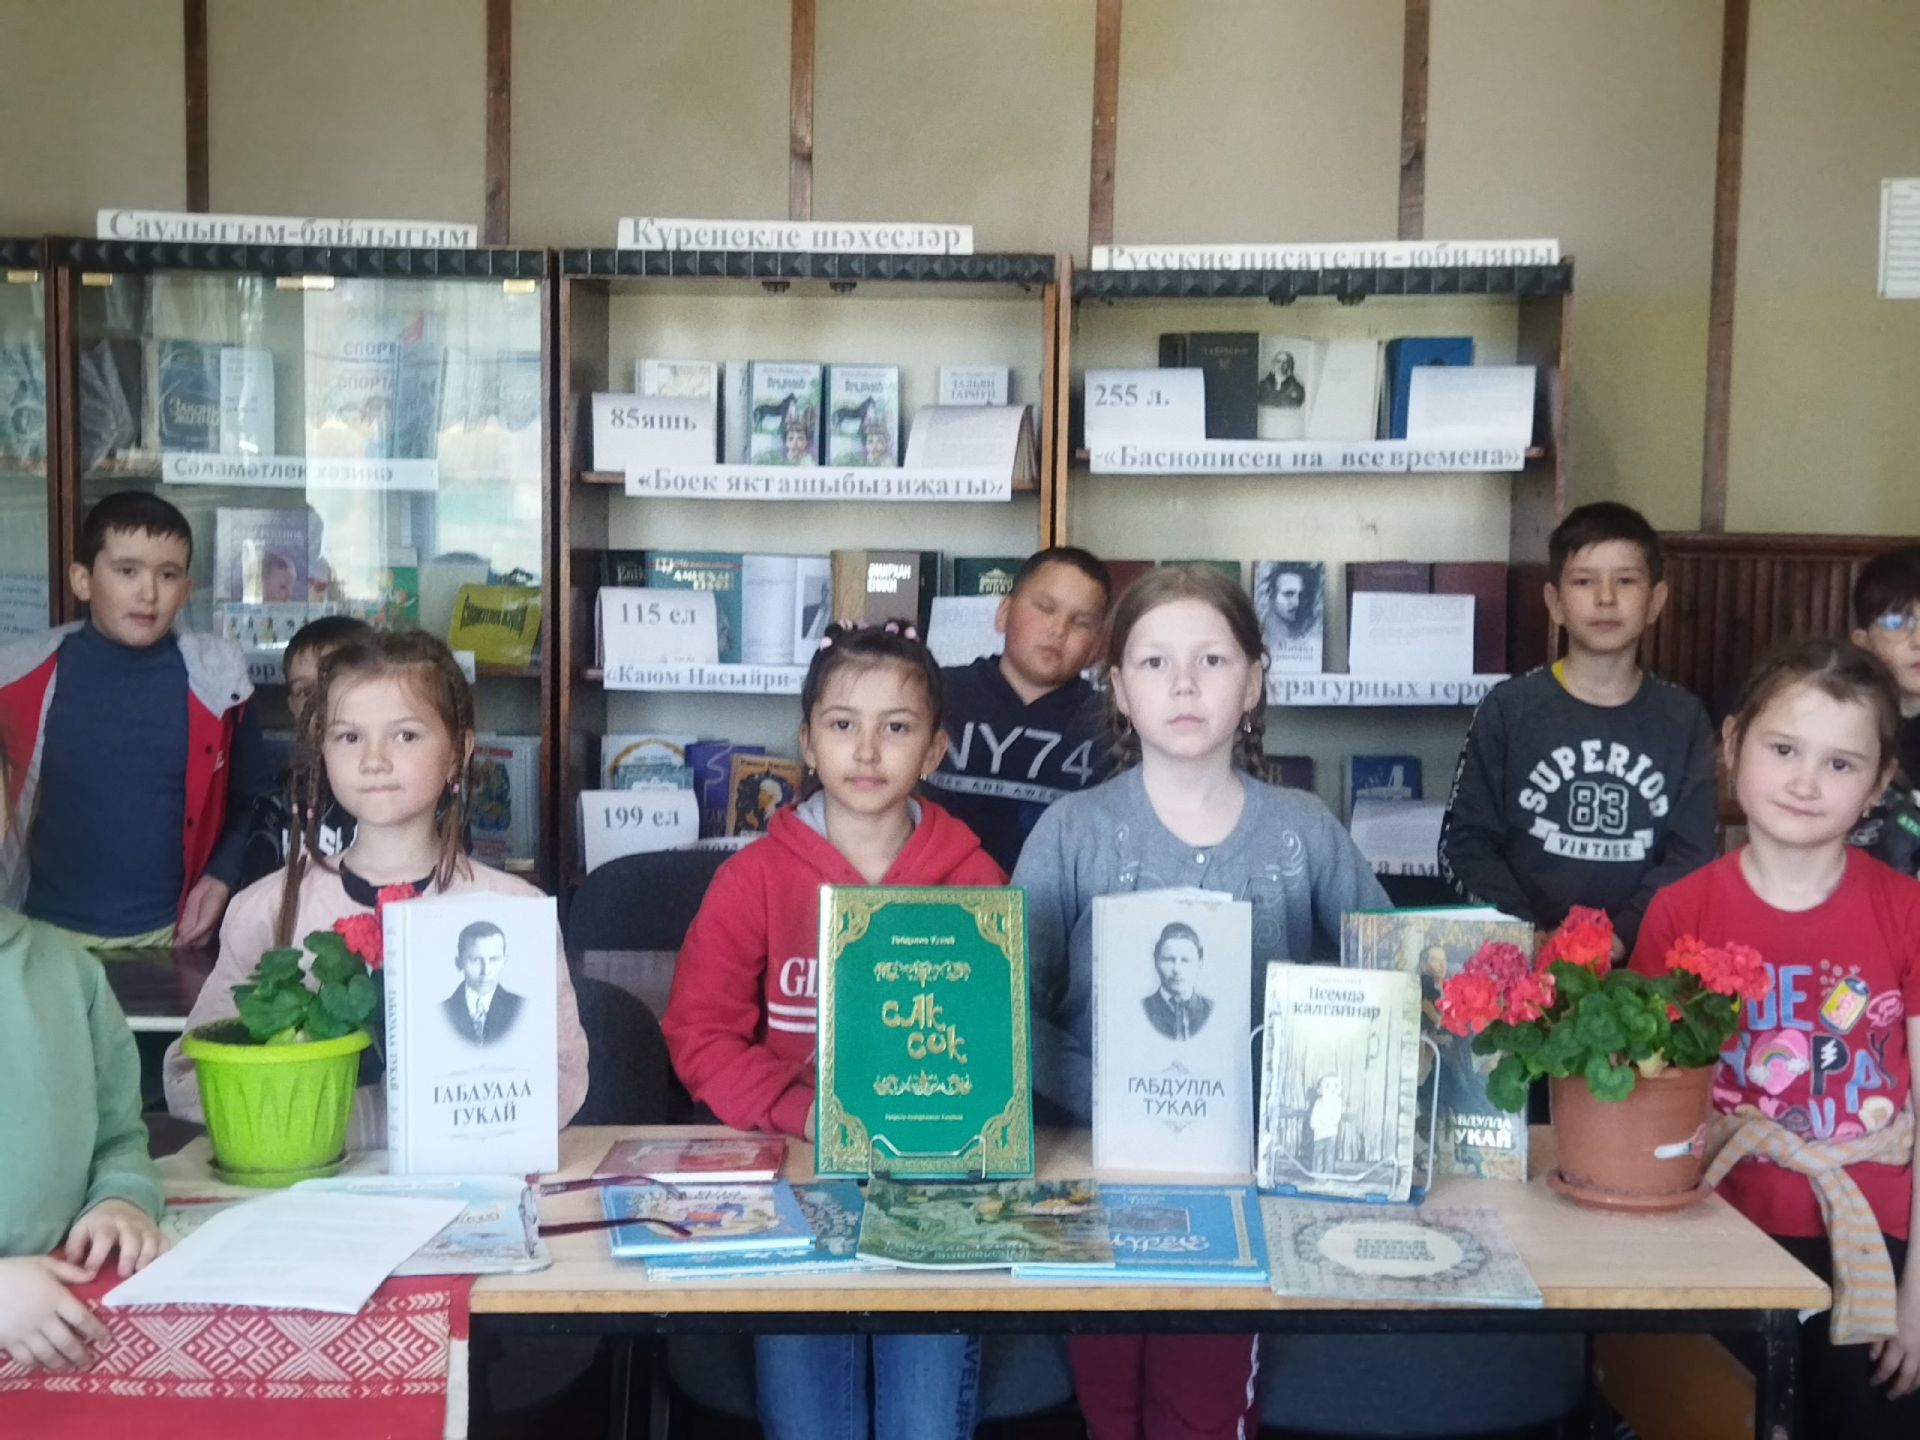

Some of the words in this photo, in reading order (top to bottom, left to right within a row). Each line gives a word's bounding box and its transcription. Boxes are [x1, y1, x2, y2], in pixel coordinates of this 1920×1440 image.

[109, 210, 471, 248] Саулыгым-байлыгым
[632, 219, 800, 250] Күренекле
[812, 227, 961, 255] шәхесләр
[1095, 384, 1138, 406] 255
[1146, 389, 1170, 406] л.
[1292, 453, 1323, 467] на
[1341, 452, 1384, 467] все
[622, 602, 661, 624] 115
[669, 609, 696, 624] ел
[688, 668, 800, 691] Насыйри-
[1270, 682, 1419, 703] ературных
[1430, 683, 1487, 704] геро
[603, 805, 643, 829] 199
[652, 810, 680, 827] ел
[1568, 780, 1630, 835] 83
[1559, 837, 1633, 858] VINTAGE
[434, 1080, 532, 1104] ГАБДУЛЛА
[1128, 1077, 1225, 1098] ГАБДУЛЛА
[453, 1101, 516, 1127] ТУКАЙ
[1143, 1098, 1207, 1118] ТУКАЙ
[1454, 1127, 1512, 1149] УКАЙ
